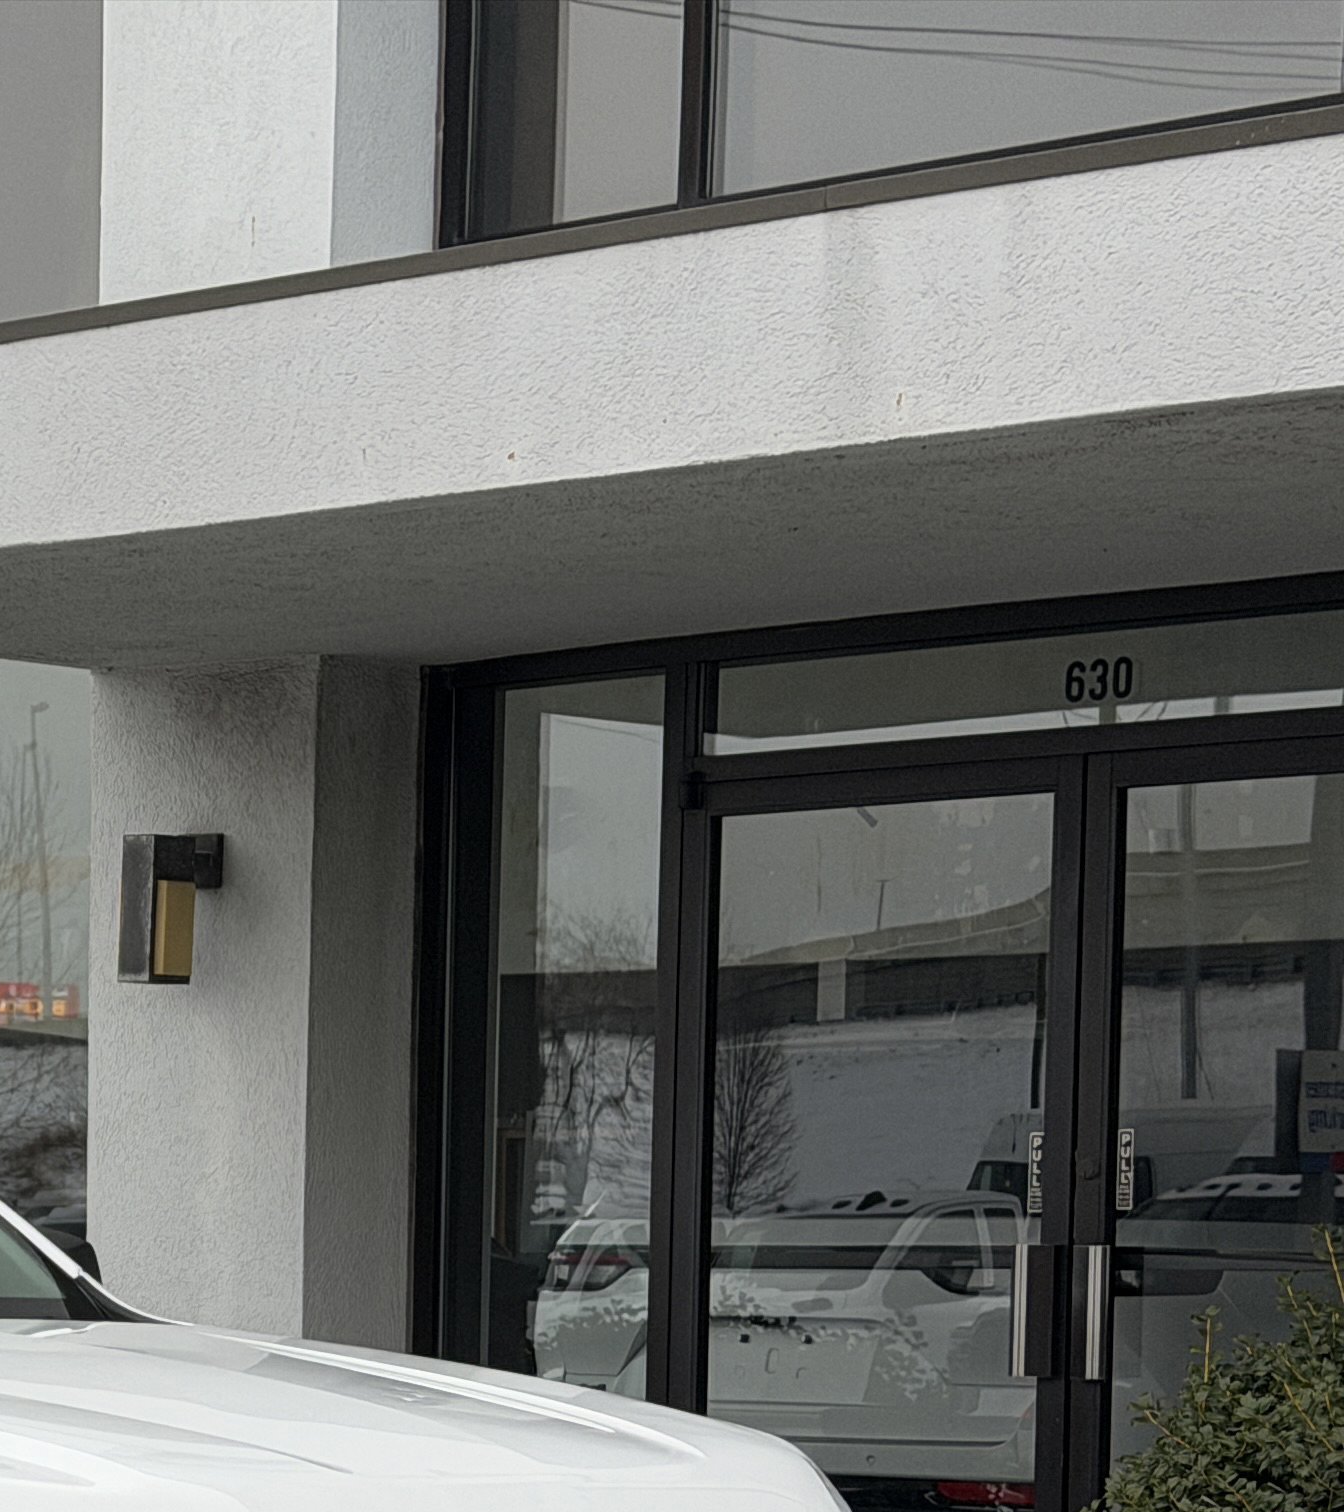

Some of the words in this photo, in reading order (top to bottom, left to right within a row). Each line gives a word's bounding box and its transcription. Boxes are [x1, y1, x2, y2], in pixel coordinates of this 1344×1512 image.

[1065, 656, 1133, 703] 630
[1031, 1136, 1043, 1187] PULL
[1119, 1133, 1132, 1184] PULL
